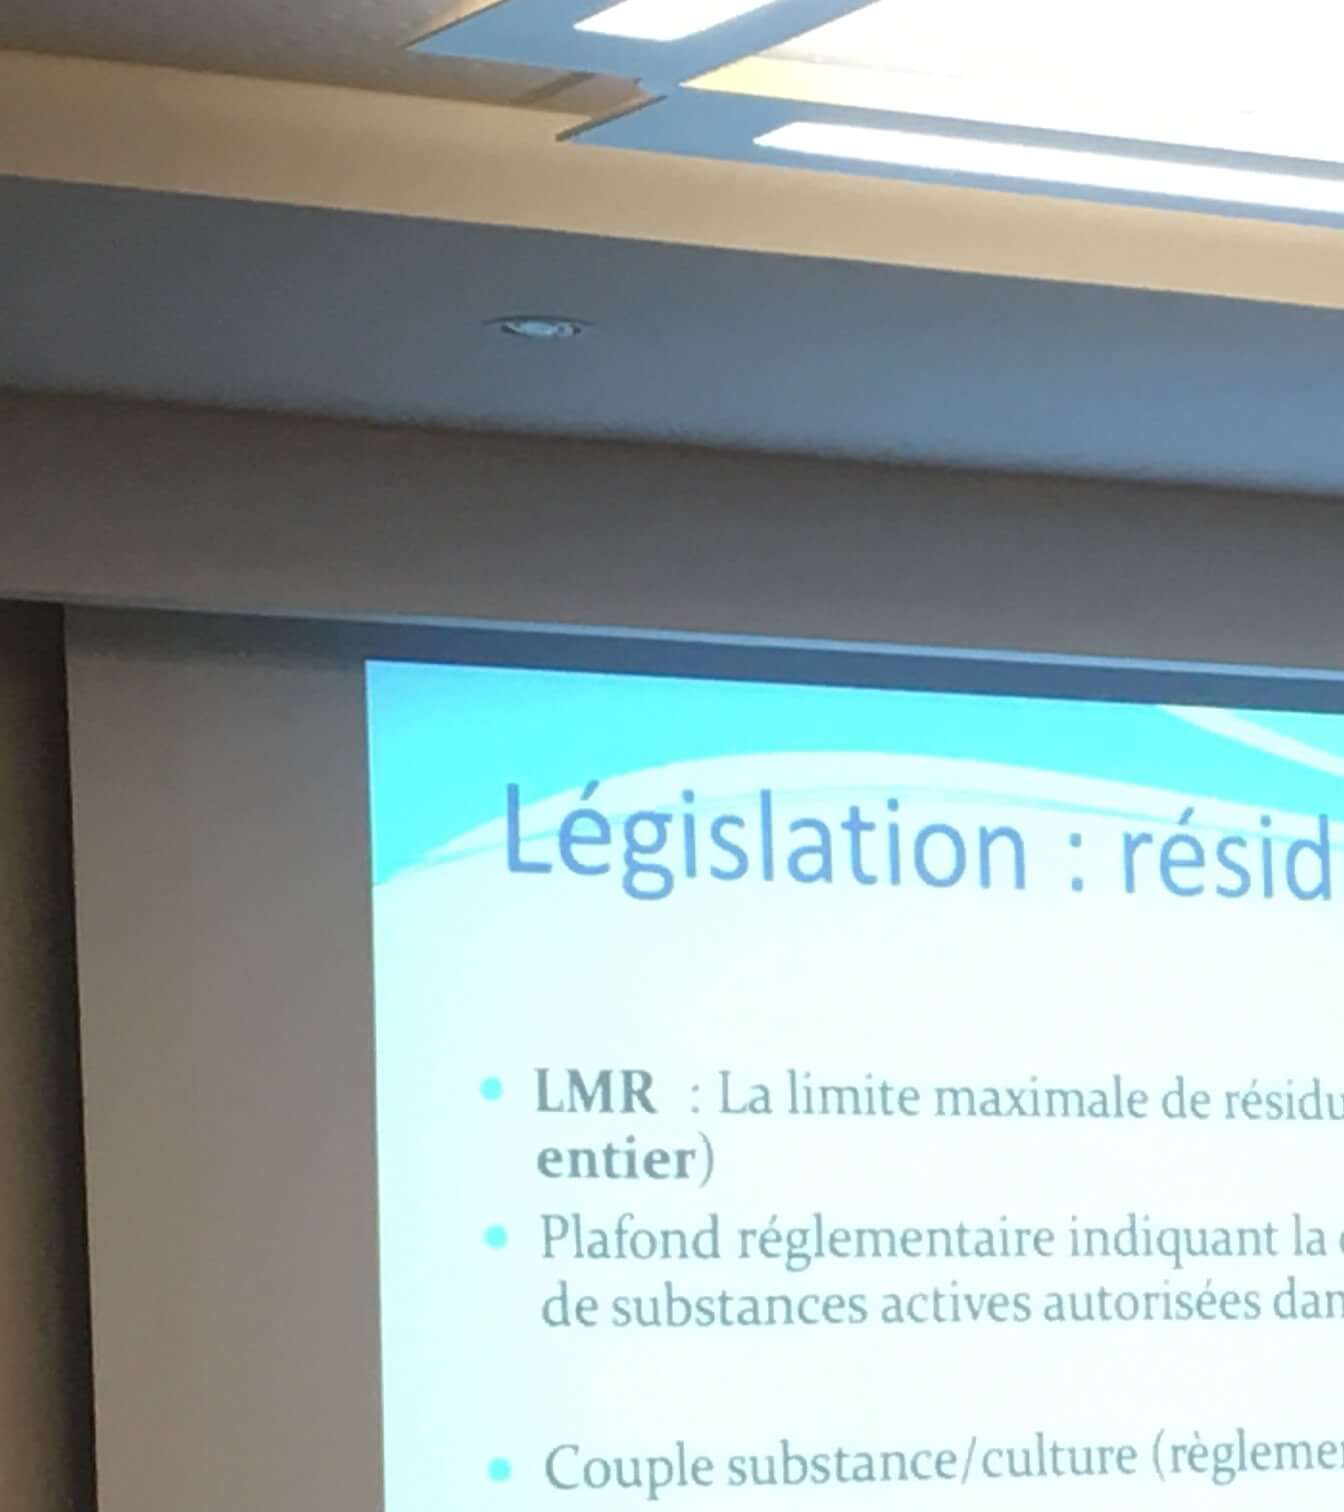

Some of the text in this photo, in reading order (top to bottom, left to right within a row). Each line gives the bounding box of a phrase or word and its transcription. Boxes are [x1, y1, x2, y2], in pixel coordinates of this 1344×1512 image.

[504, 781, 1028, 900] Législation
[1069, 831, 1086, 892] :
[535, 1068, 657, 1114] LMR
[689, 1082, 701, 1115] :
[719, 1070, 773, 1114] La
[787, 1068, 920, 1116] limite
[934, 1074, 1148, 1119] maximale
[1161, 1075, 1211, 1120] de
[537, 1132, 714, 1186] entier)
[541, 1212, 720, 1260] Plafond
[738, 1212, 1055, 1273] réglementaire
[1070, 1212, 1278, 1270] indiquant
[1293, 1213, 1327, 1256] la
[542, 1280, 598, 1327] de
[612, 1281, 868, 1327] substances
[881, 1280, 1032, 1324] actives
[1043, 1279, 1261, 1322] autorisées
[545, 1440, 714, 1501] Couple
[728, 1432, 1137, 1486] substance/culture
